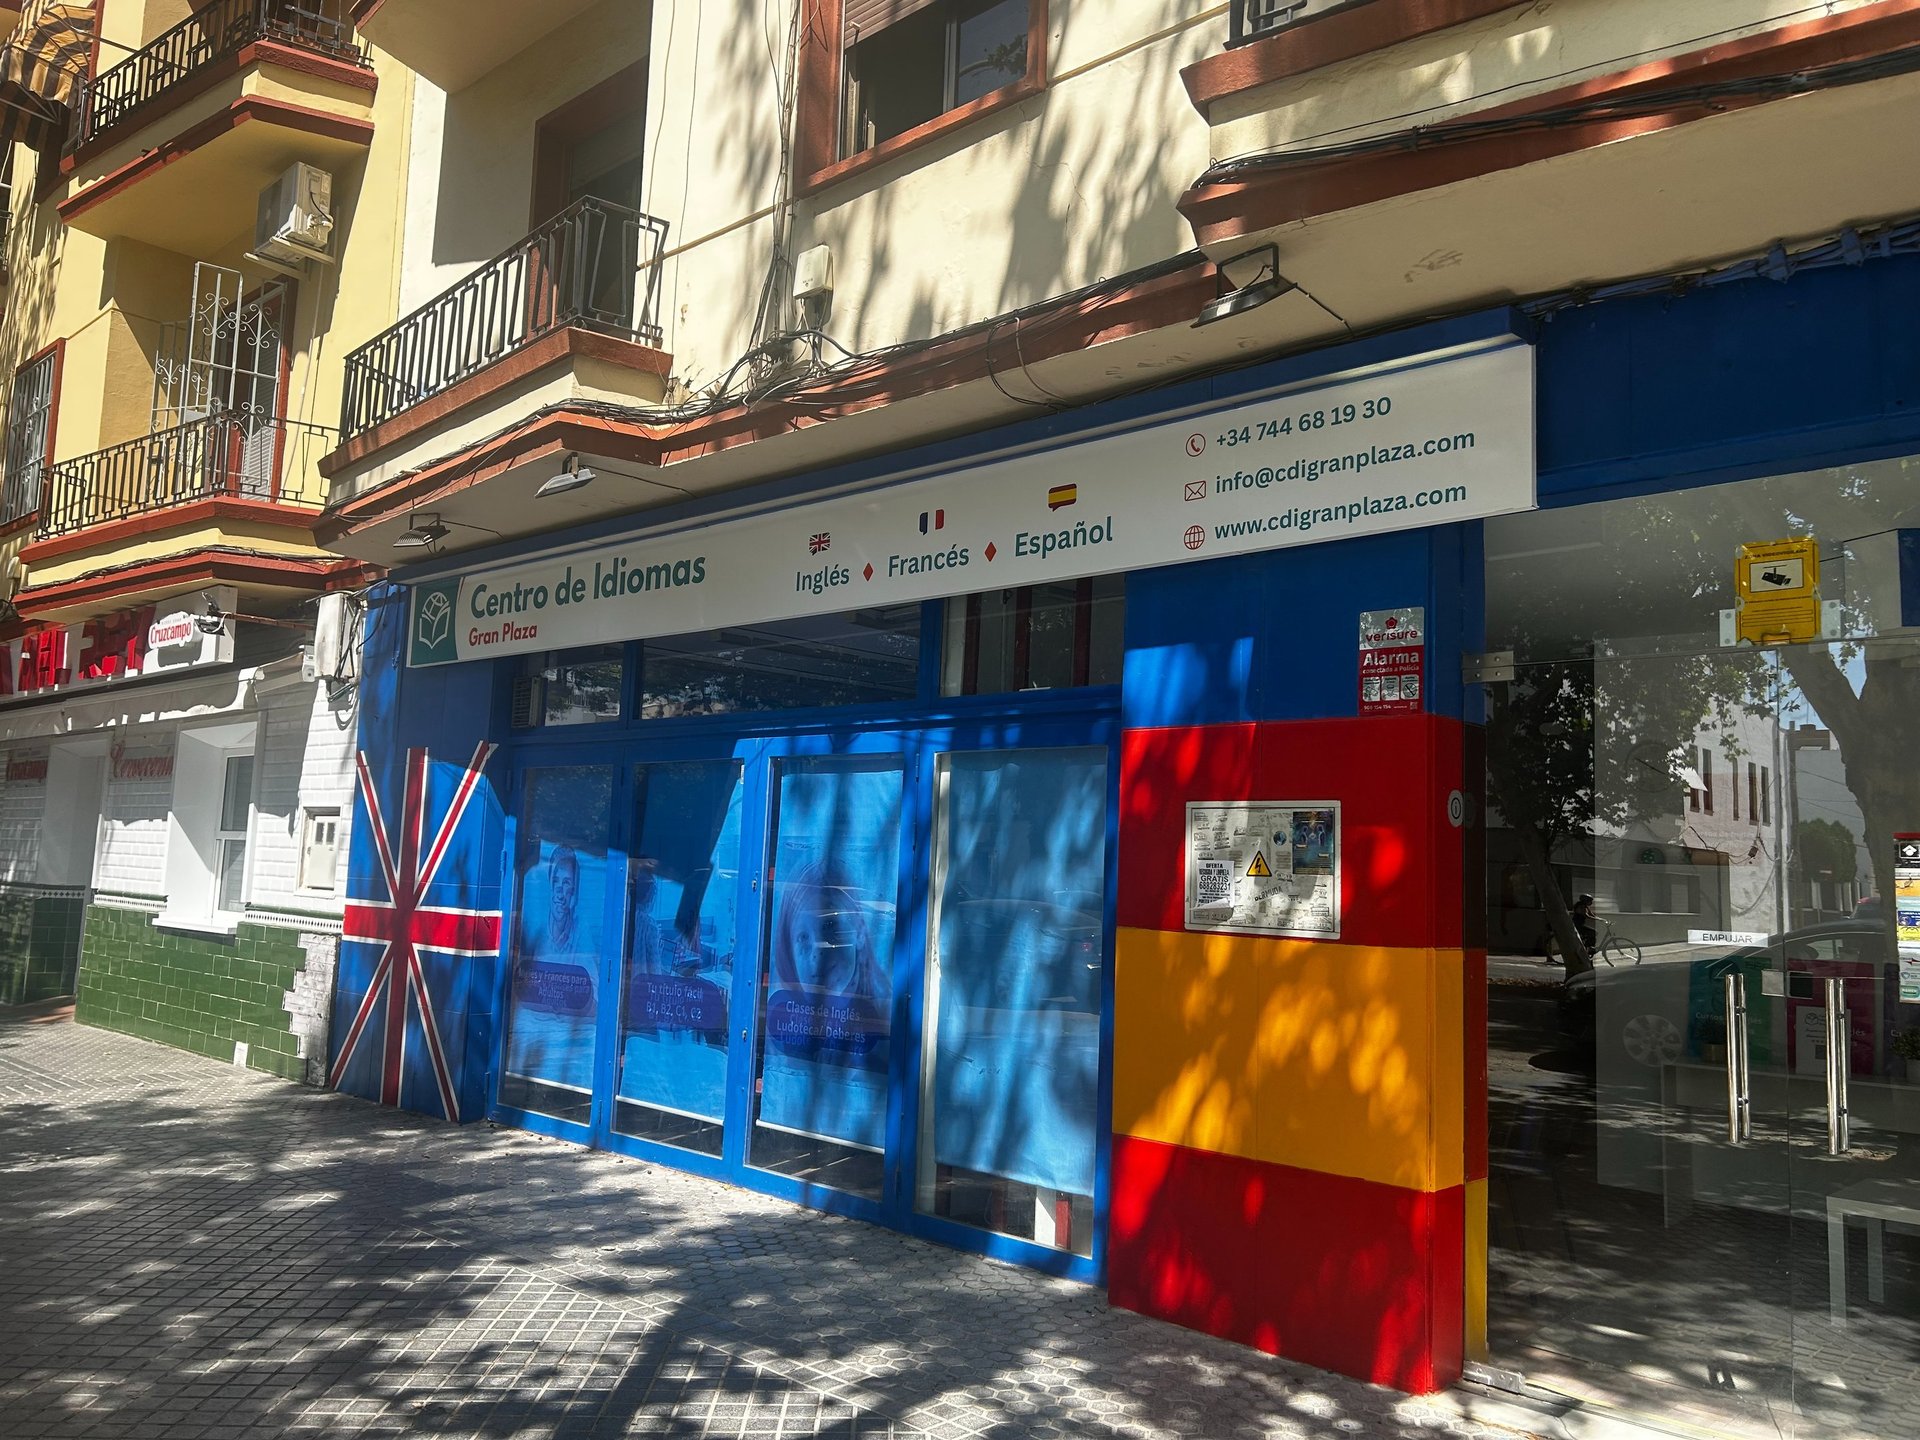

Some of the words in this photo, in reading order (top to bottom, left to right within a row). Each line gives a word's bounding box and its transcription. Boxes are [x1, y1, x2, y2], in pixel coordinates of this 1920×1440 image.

[1216, 426, 1251, 447] +34
[1256, 417, 1292, 440] 744
[1298, 410, 1325, 432] 68
[1330, 404, 1356, 426] 19
[1362, 396, 1392, 419] 30
[1215, 431, 1475, 494] info@cdigranplaza.com
[1214, 484, 1467, 540] www.cdigranplaza.com
[1015, 515, 1113, 560] Español
[888, 543, 970, 578] Francés
[470, 583, 548, 619] Centro
[555, 567, 586, 606] de
[593, 555, 706, 600] Idiomas
[795, 563, 850, 595] Inglés
[150, 622, 192, 644] Cruzcampo
[469, 626, 499, 647] Gran
[502, 622, 538, 643] Plaza
[1365, 629, 1418, 642] verisure
[1363, 651, 1419, 667] Alarma
[1702, 932, 1753, 944] EMPUJAR
[544, 970, 570, 984] Francés
[571, 976, 587, 987] para
[659, 982, 682, 997] título
[684, 985, 704, 999] fácil
[538, 986, 564, 999] Adultos
[786, 1000, 815, 1015] Clases
[817, 1003, 829, 1017] de
[831, 1006, 860, 1023] Inglés
[776, 1019, 824, 1037] Ludoteca/
[825, 1026, 866, 1043] Deberes
